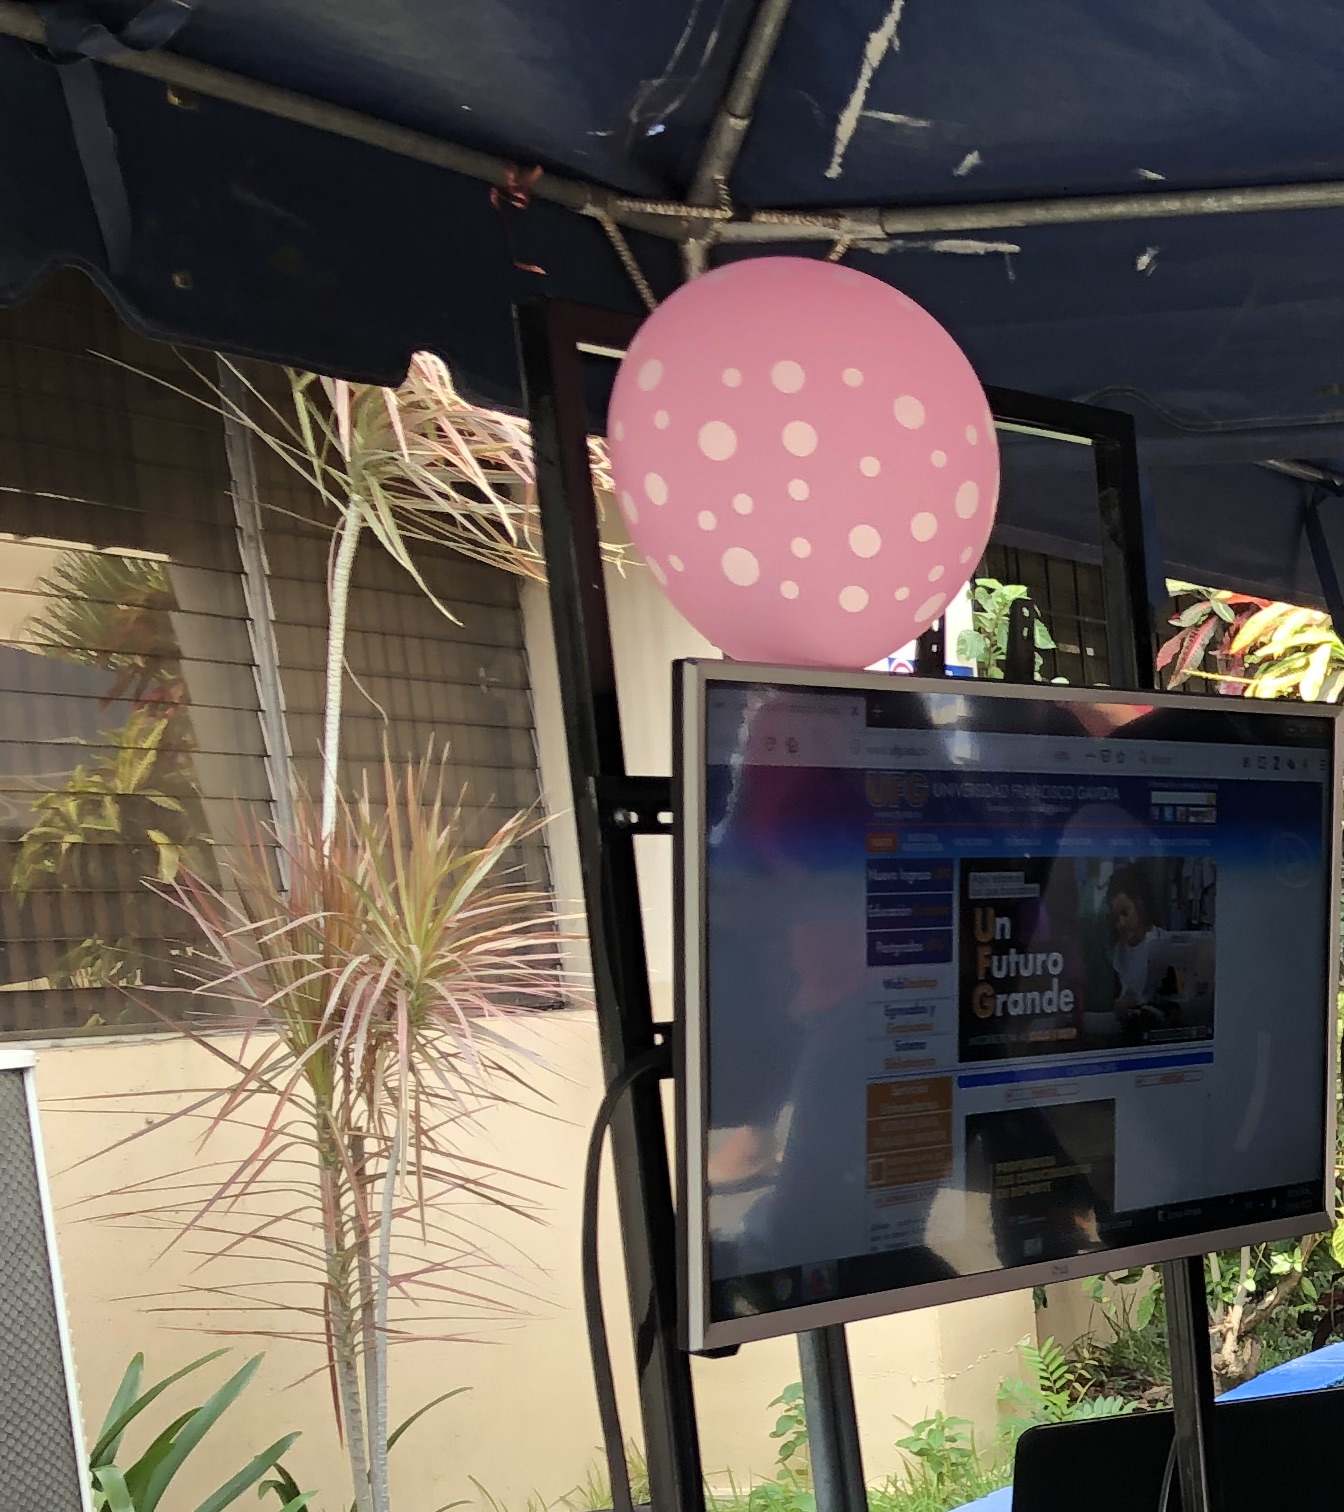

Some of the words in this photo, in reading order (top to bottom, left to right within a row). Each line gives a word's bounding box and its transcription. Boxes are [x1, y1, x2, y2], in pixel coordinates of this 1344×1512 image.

[866, 773, 928, 807] UFG
[932, 782, 1008, 799] UNIVERSIDAD
[1010, 784, 1073, 800] FRANCISCO
[1078, 785, 1120, 801] GAVIDIA
[973, 906, 1012, 943] Un
[977, 945, 1065, 981] Futuro
[972, 979, 1075, 1018] Grande
